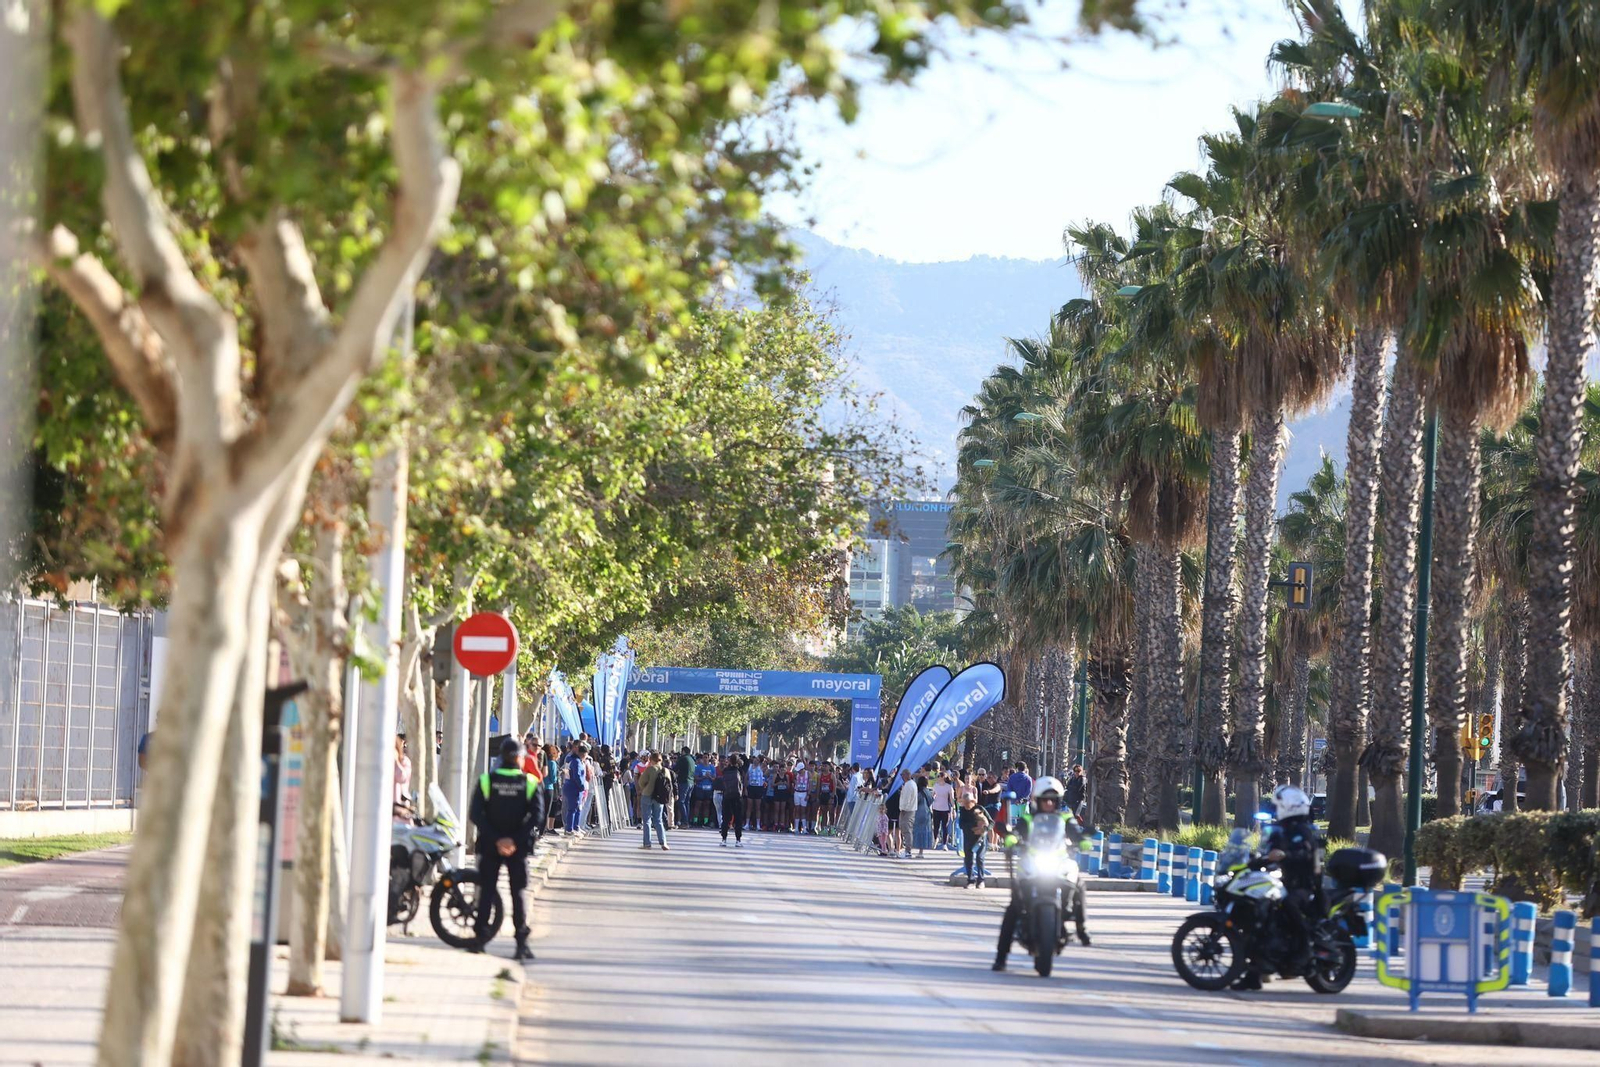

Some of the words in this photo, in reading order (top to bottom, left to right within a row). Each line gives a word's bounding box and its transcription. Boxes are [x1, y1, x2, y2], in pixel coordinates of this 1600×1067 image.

[715, 671, 763, 679] RUNNING
[720, 678, 759, 686] MAKES
[811, 679, 871, 693] mayoral
[893, 683, 939, 749] mayoral
[923, 680, 989, 746] mayoral
